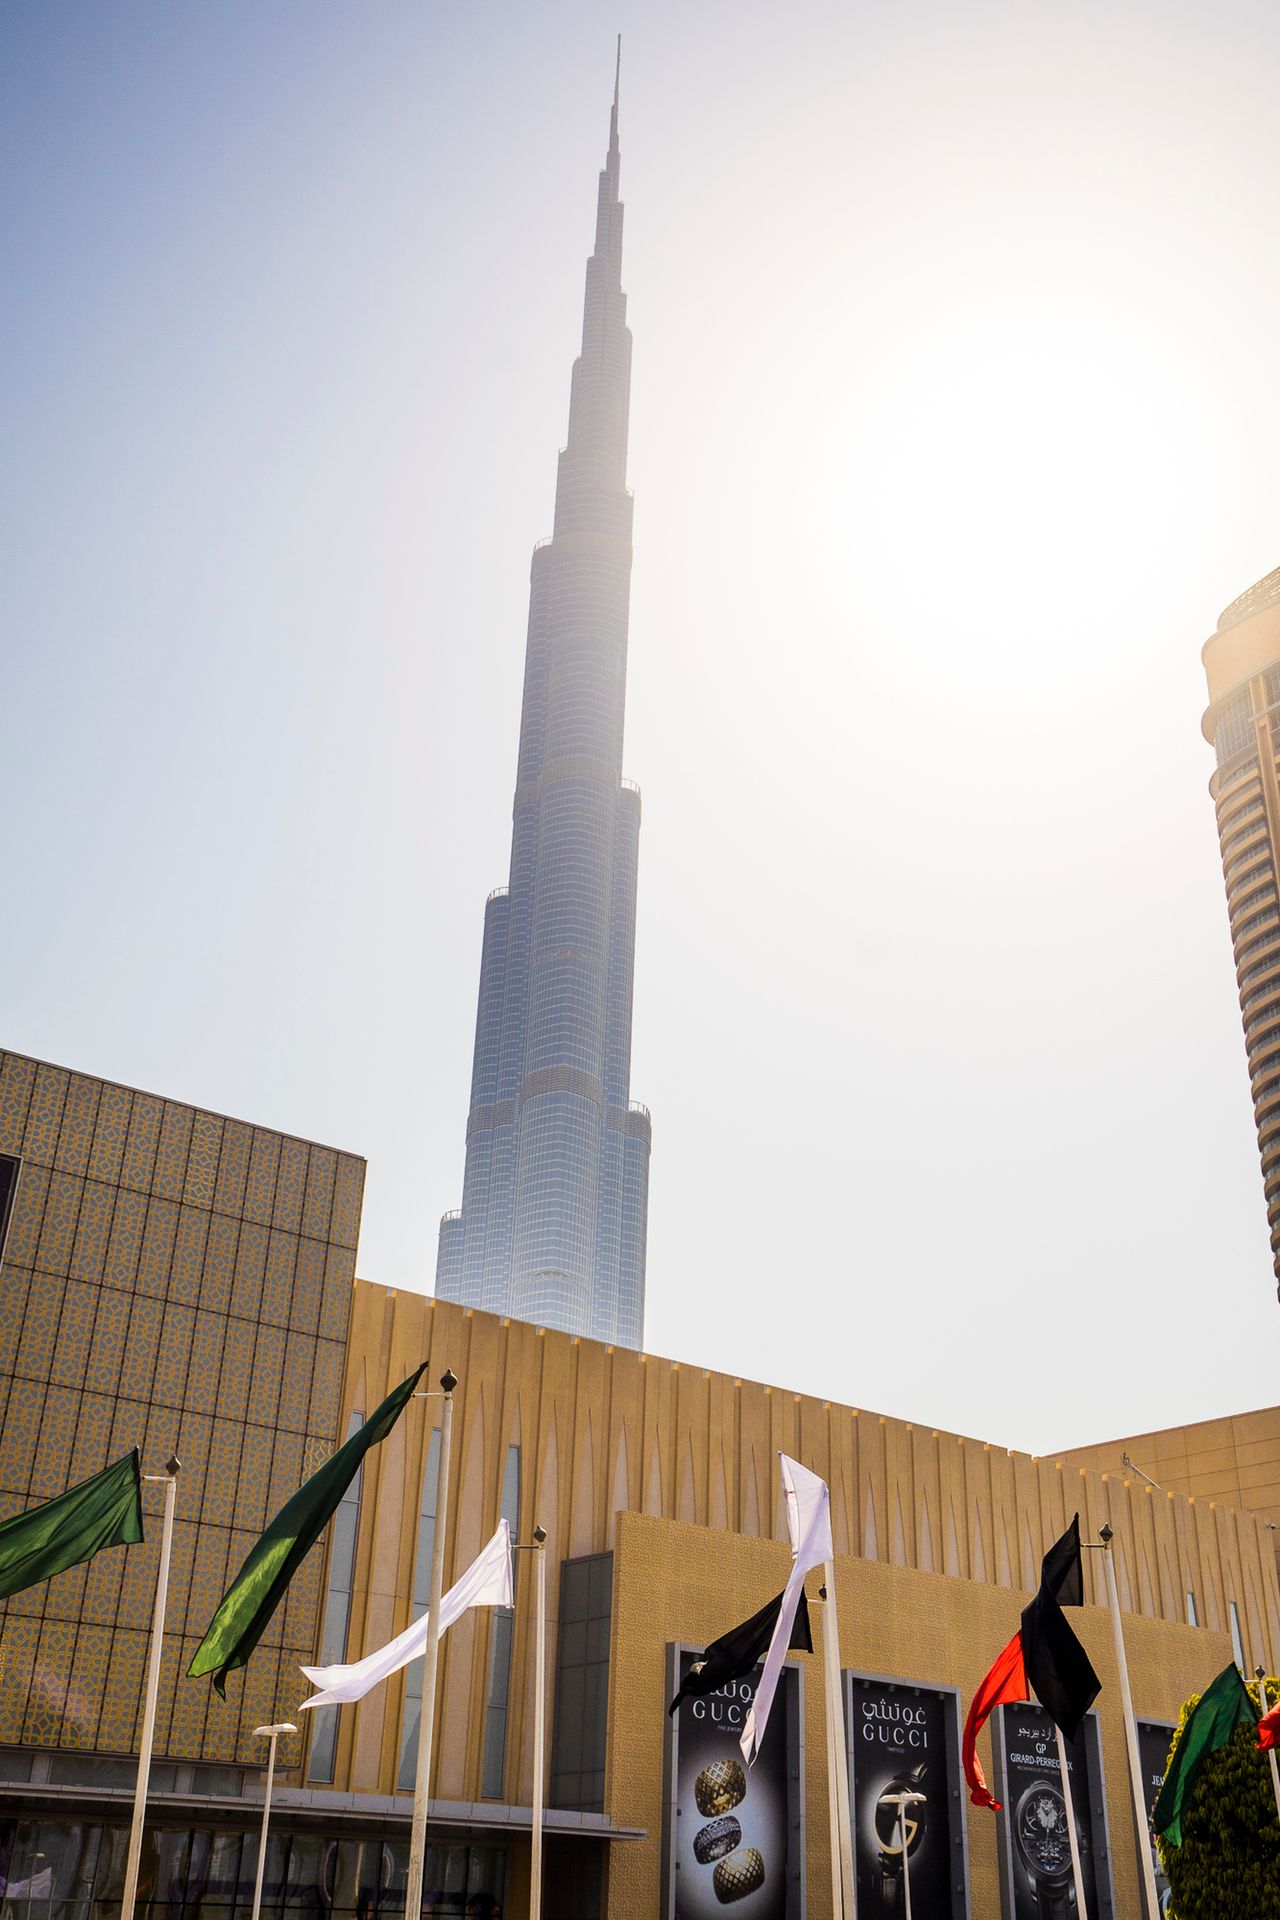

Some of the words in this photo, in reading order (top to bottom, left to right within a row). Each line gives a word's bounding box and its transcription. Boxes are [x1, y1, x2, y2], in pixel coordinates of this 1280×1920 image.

[692, 1700, 753, 1724] GUC
[862, 1698, 927, 1726] غوتشي
[863, 1723, 928, 1748] GUCCI
[1035, 1742, 1047, 1754] GP
